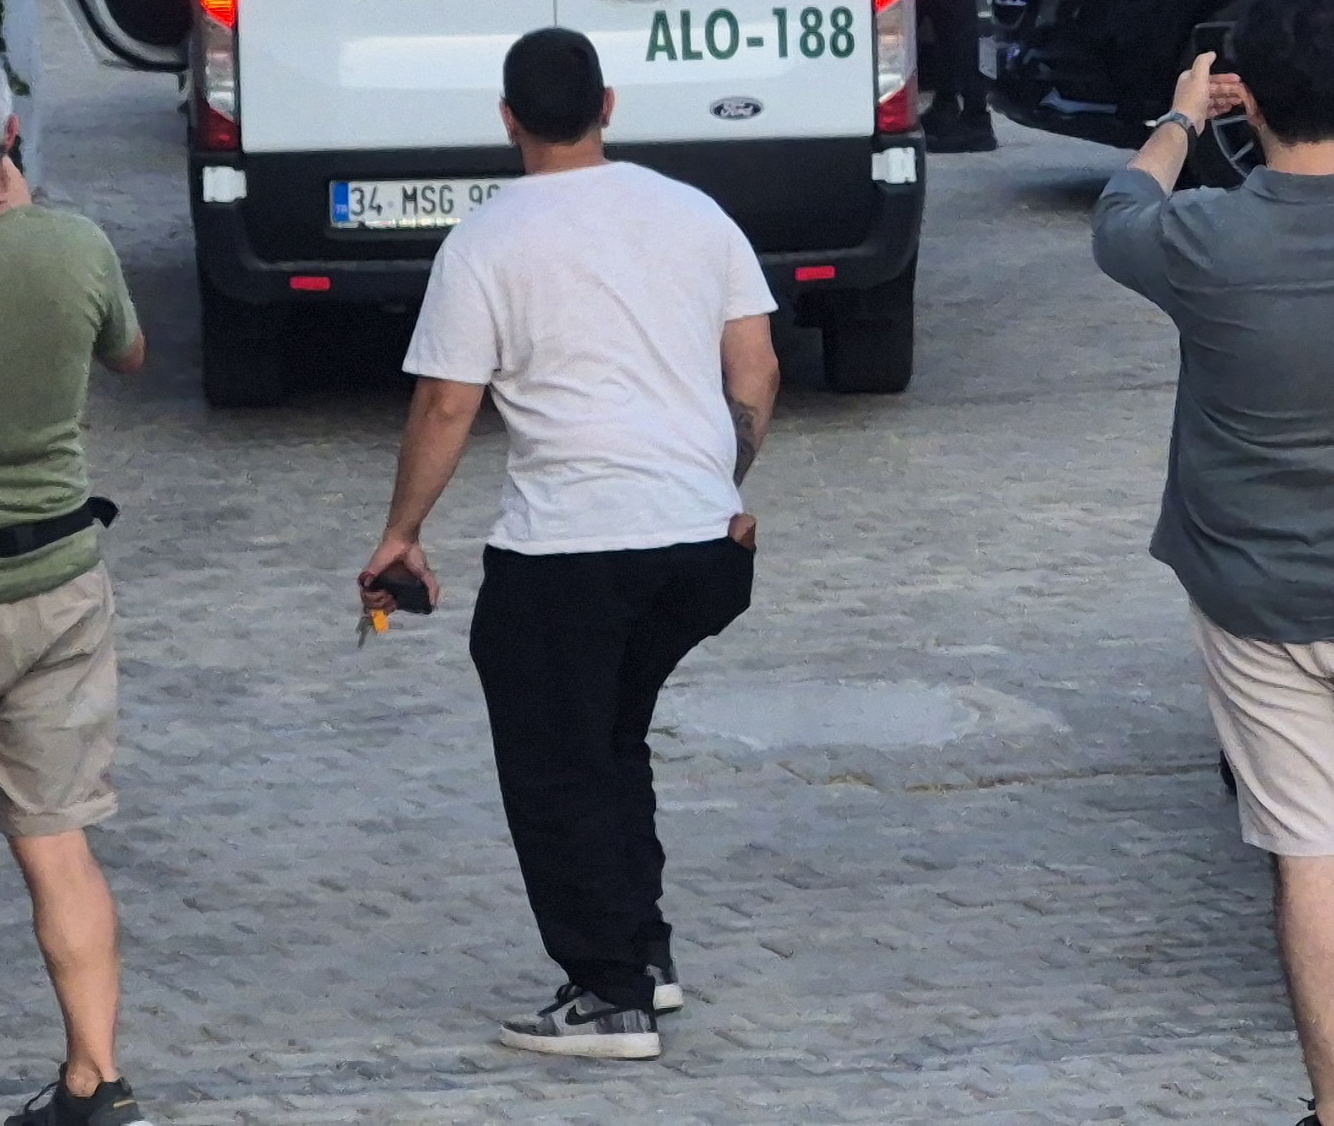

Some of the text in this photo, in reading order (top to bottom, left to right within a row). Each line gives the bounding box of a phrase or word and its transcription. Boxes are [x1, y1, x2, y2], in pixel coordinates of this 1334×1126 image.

[646, 6, 855, 62] ALO-188
[350, 186, 383, 216] 34
[401, 184, 455, 215] MSG
